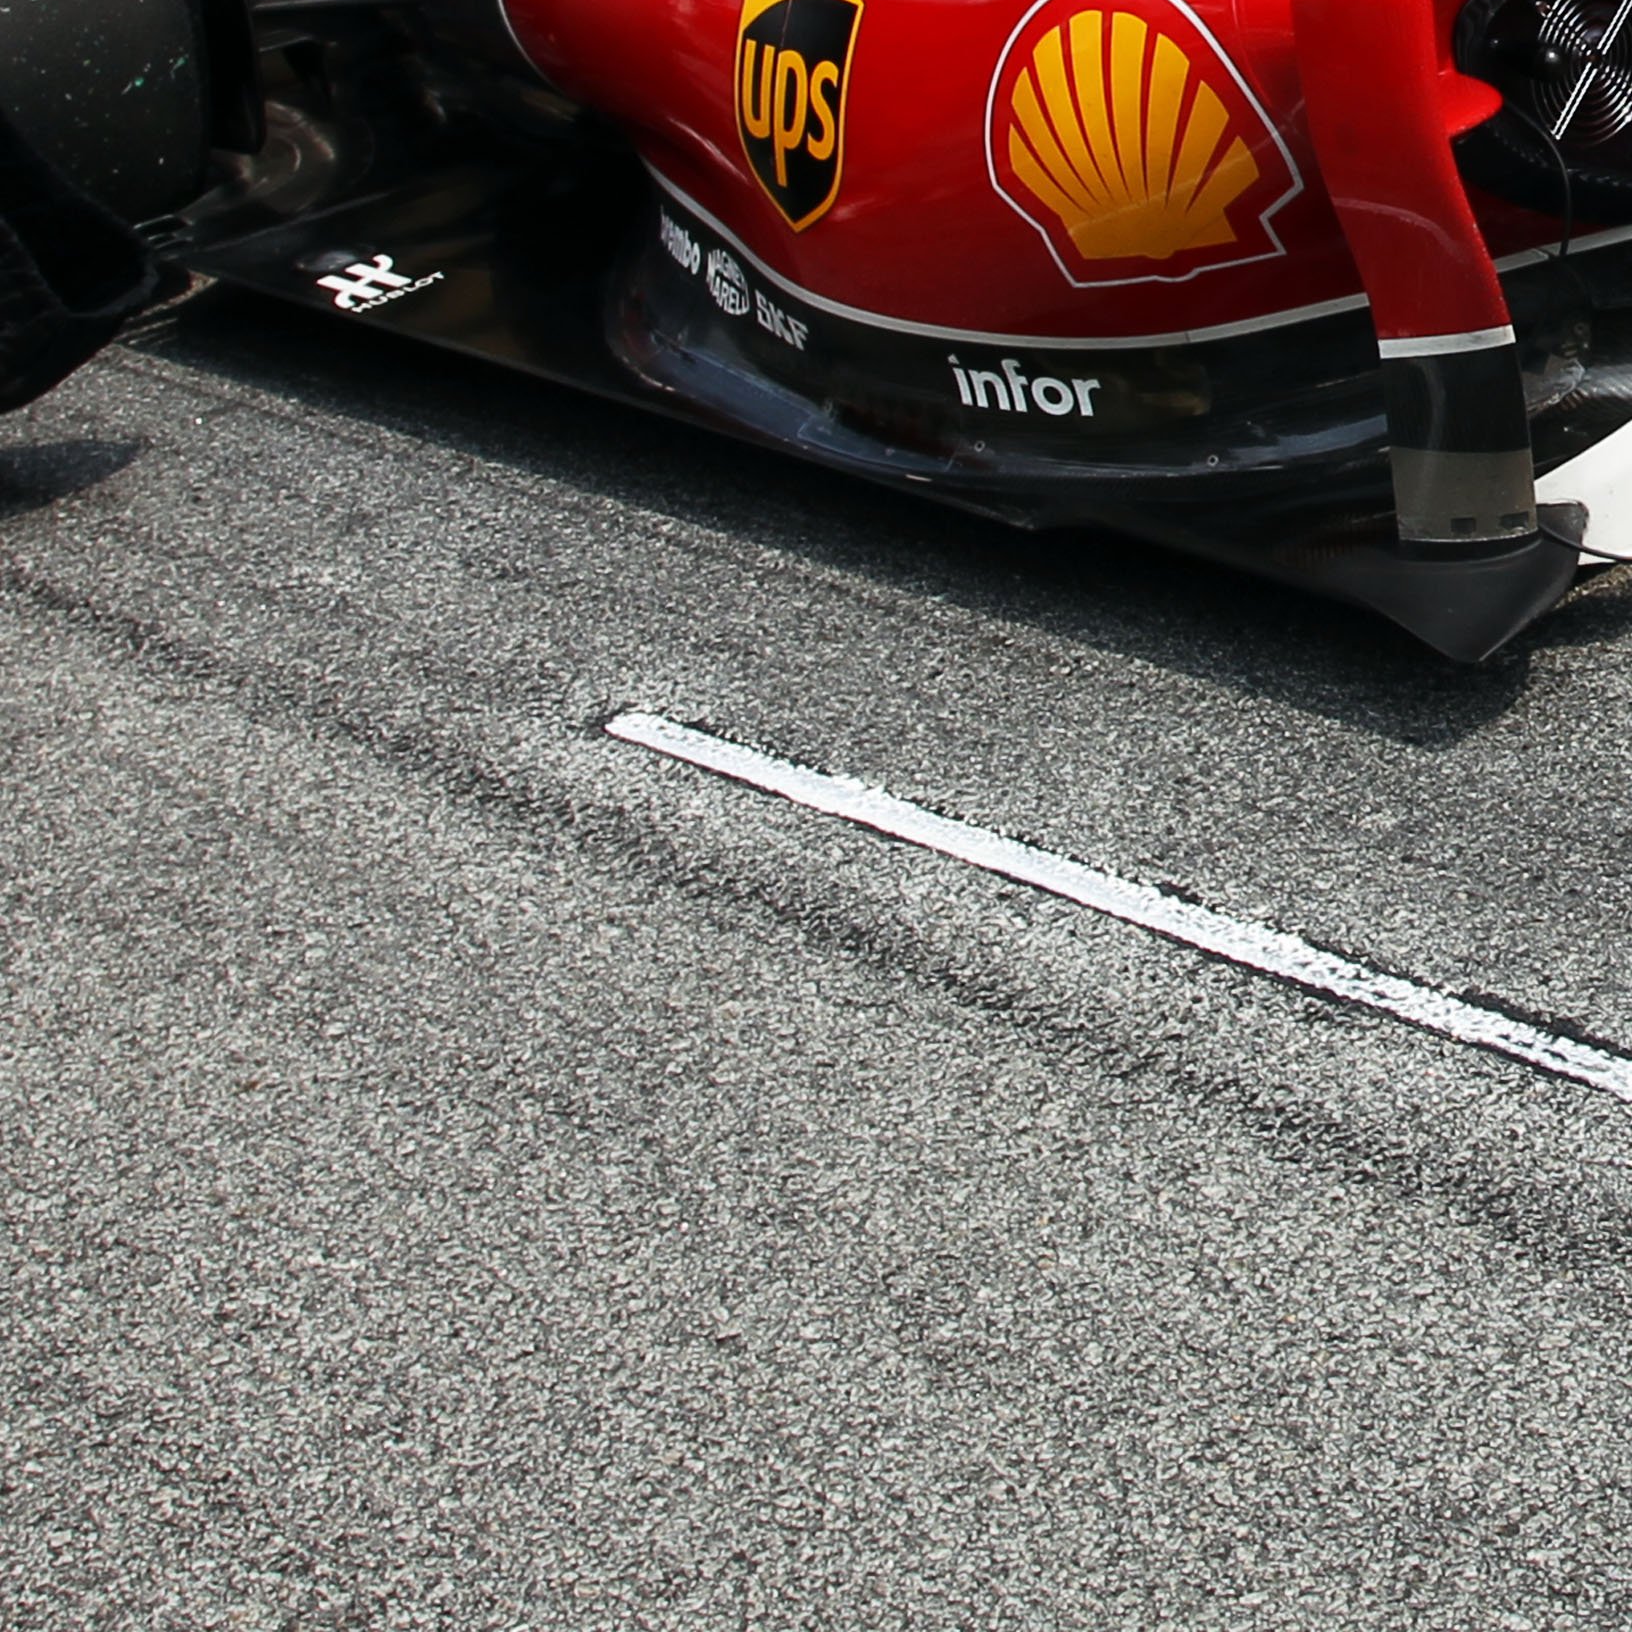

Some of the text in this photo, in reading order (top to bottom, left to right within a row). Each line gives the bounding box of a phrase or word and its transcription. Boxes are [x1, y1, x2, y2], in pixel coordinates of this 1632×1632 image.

[742, 39, 838, 186] ups
[351, 270, 445, 313] HUBLOT
[754, 288, 809, 351] SKF
[947, 354, 1100, 417] infor
